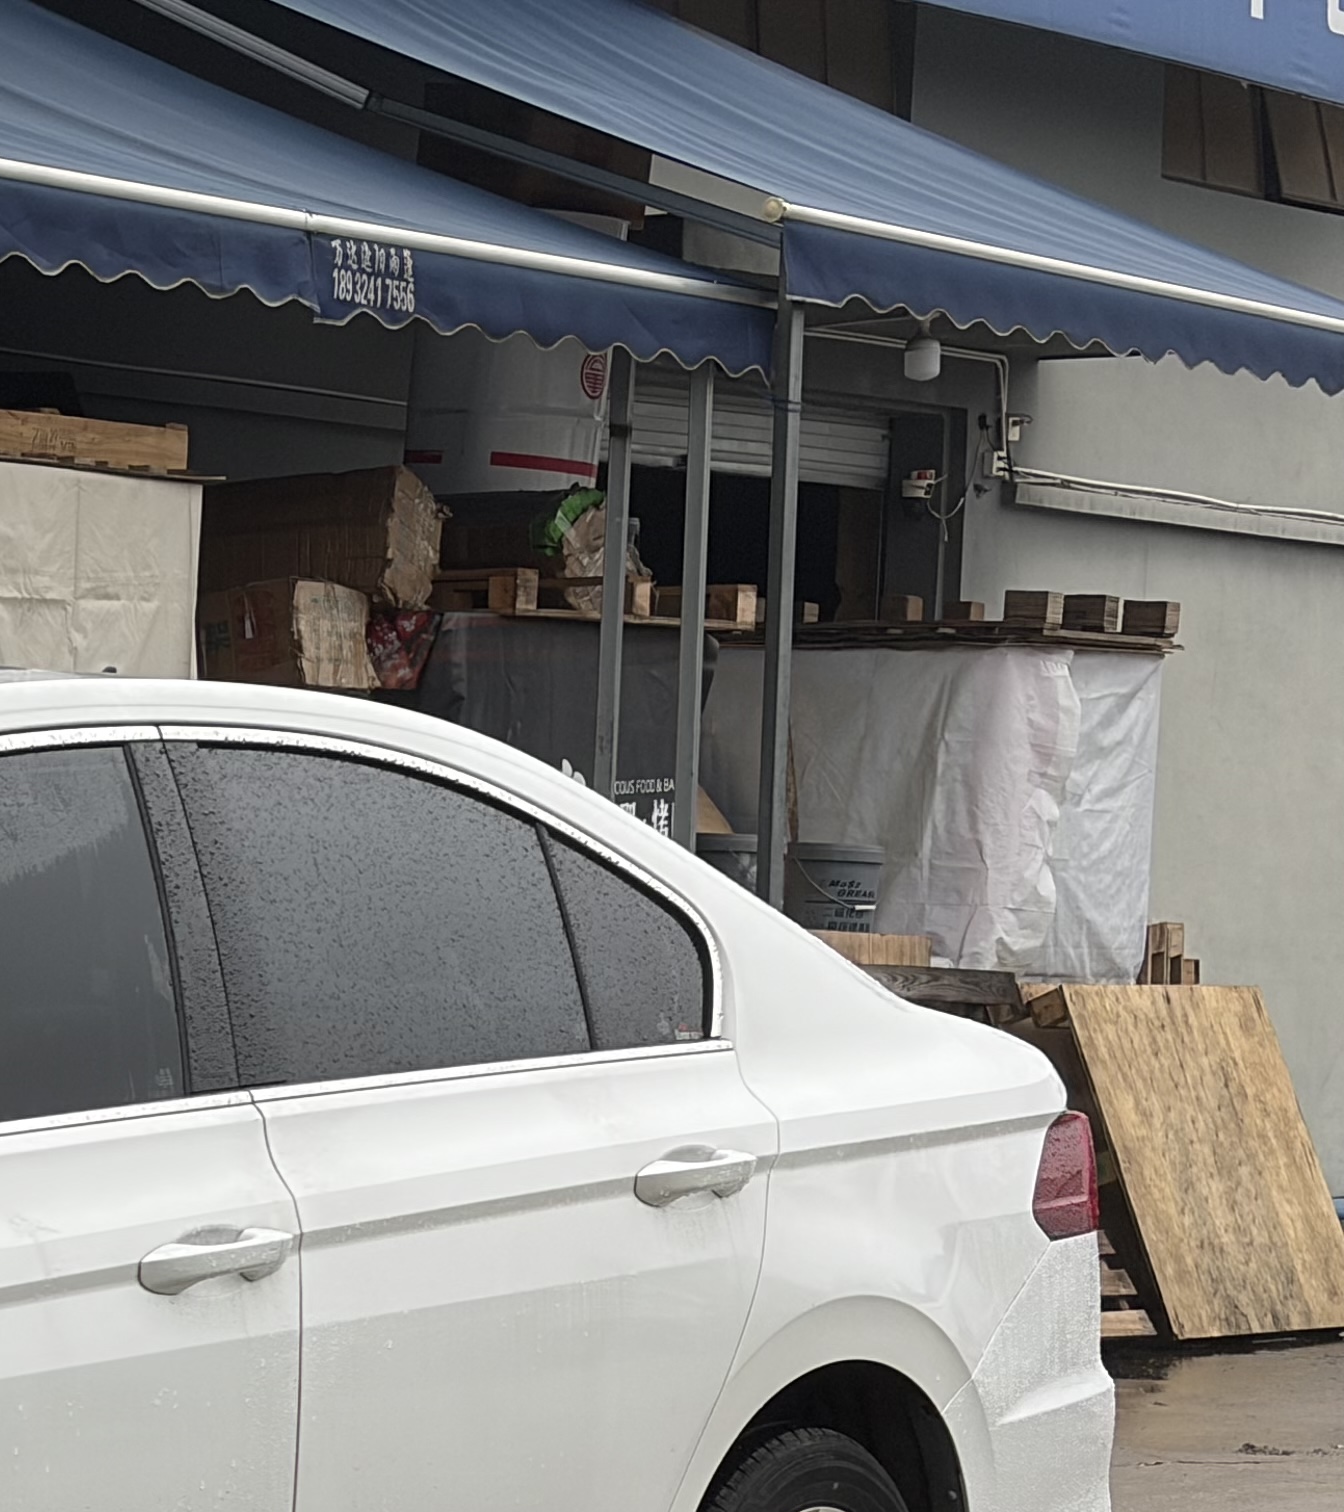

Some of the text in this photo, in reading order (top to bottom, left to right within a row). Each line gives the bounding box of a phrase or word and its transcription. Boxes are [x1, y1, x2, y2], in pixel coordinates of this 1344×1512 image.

[332, 267, 416, 313] 189 3241 7556
[636, 779, 655, 794] FOOD
